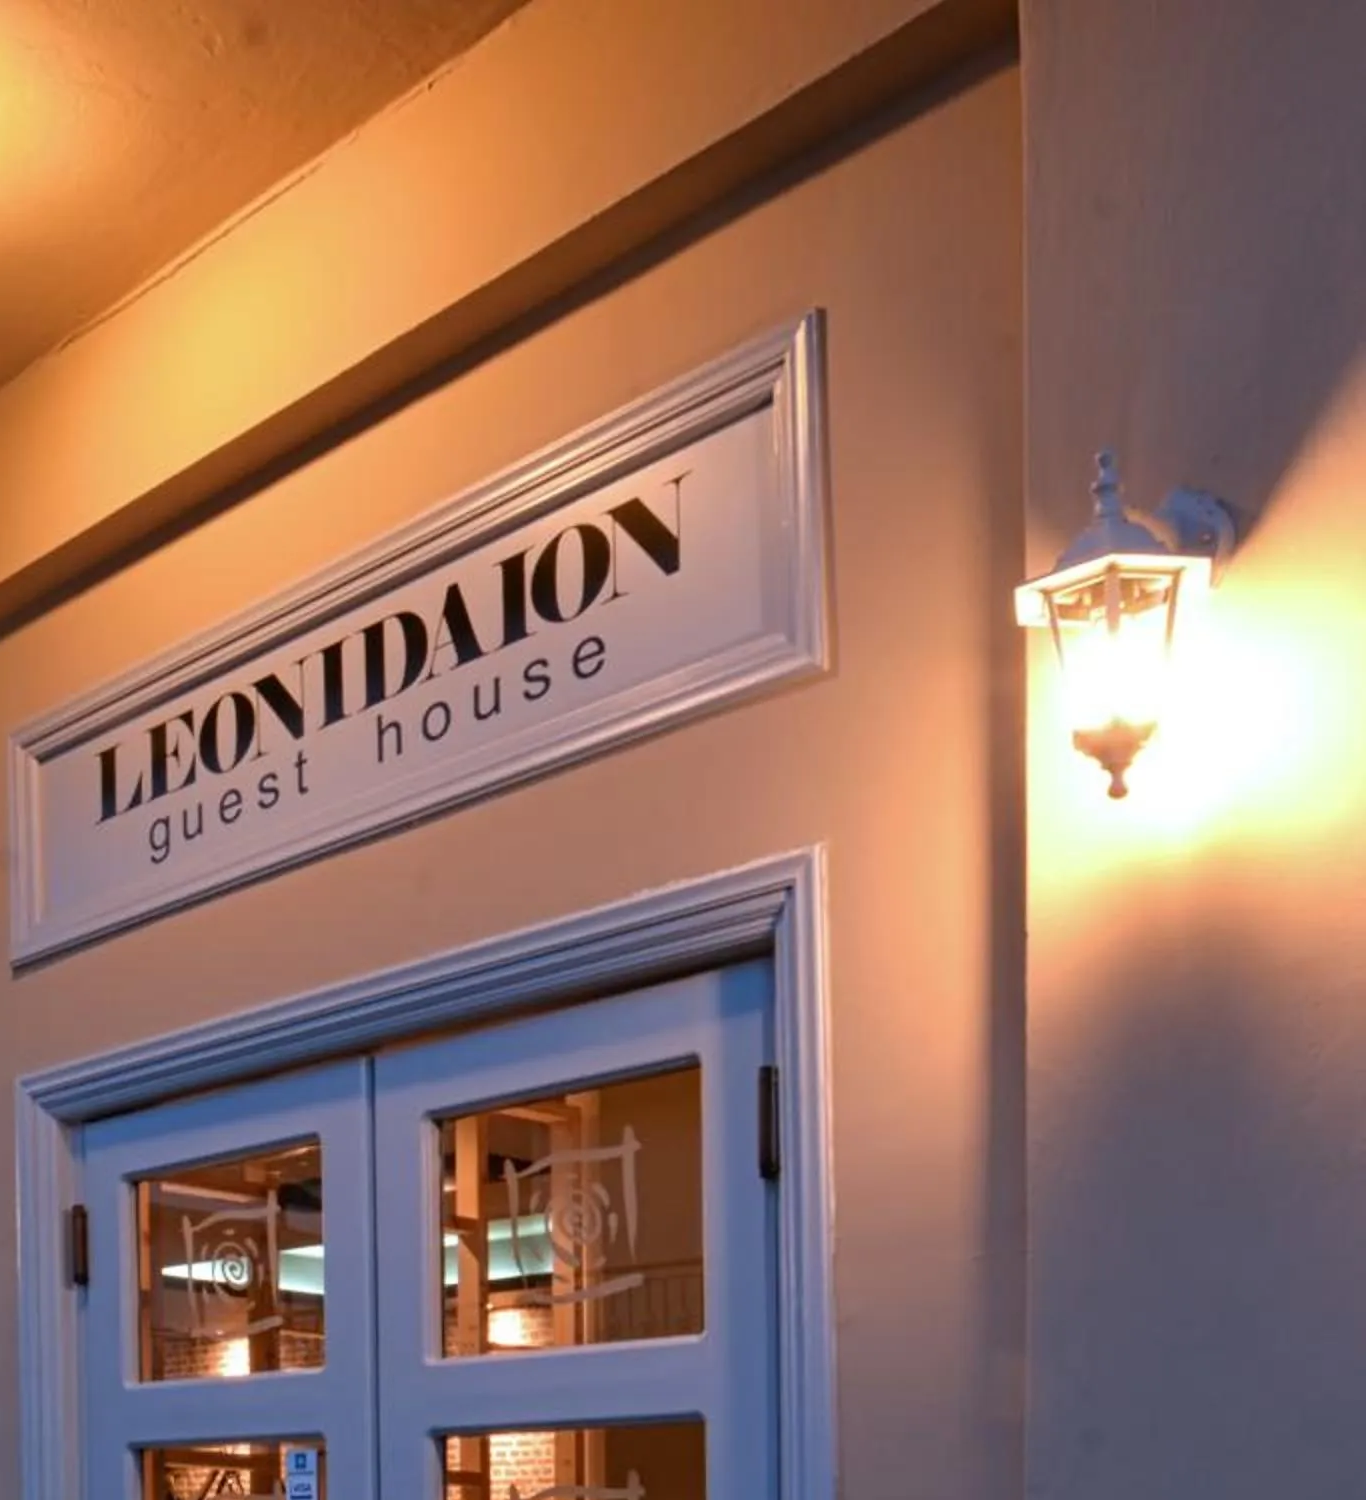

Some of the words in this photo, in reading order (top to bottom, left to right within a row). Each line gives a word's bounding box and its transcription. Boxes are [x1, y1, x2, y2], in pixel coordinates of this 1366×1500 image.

[95, 469, 692, 825] LEONIDAION
[148, 750, 309, 864] guest
[376, 635, 606, 762] house
